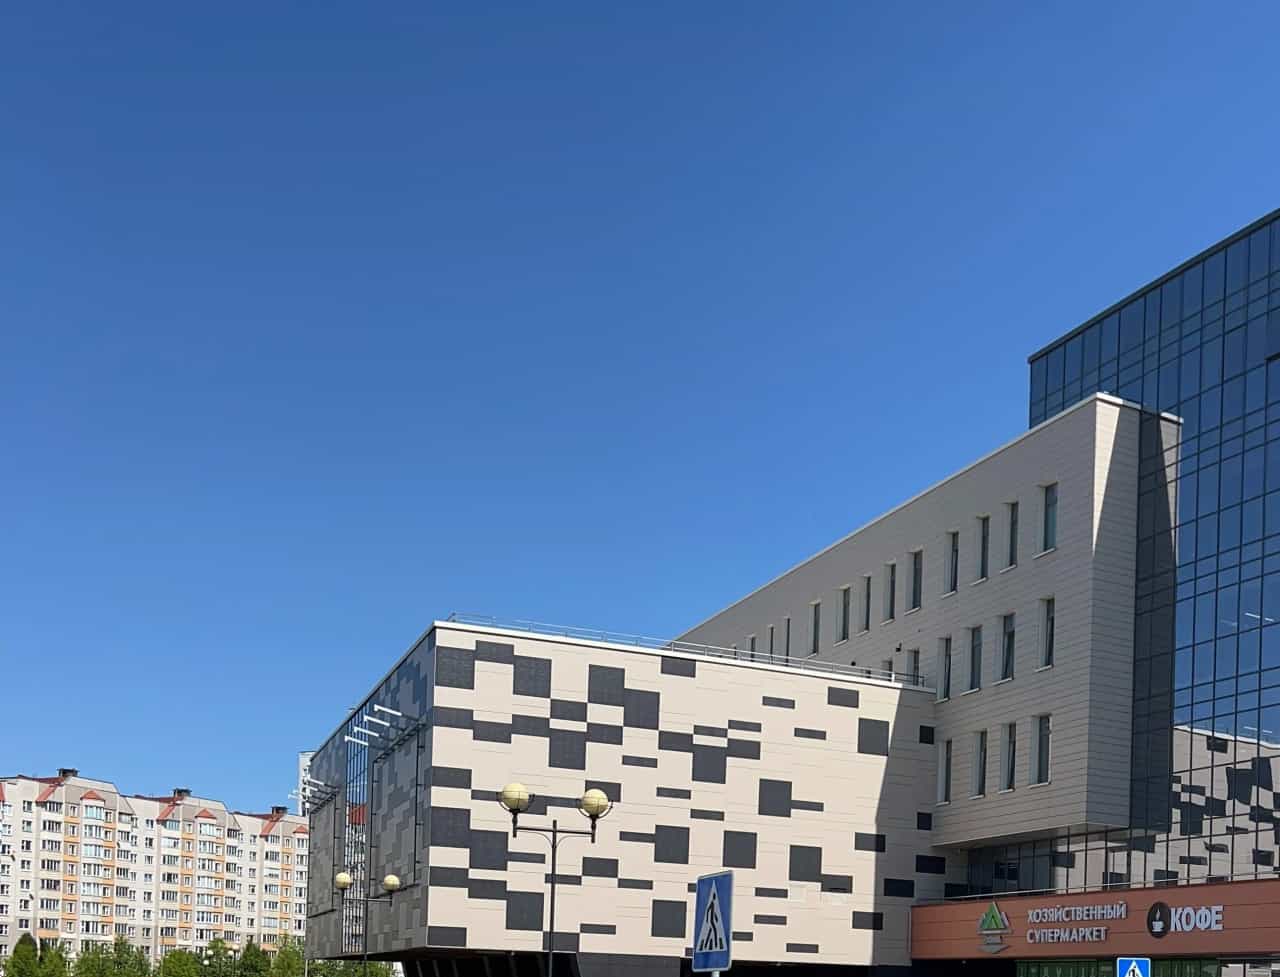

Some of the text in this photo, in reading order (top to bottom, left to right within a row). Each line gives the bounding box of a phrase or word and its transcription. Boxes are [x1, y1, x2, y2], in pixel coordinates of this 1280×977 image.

[1028, 901, 1127, 923] ХОЗЯЙСТВЕННЫЙ
[1170, 905, 1223, 932] КОФЕ
[1027, 926, 1109, 944] СУПЕРМАРКЕТ
